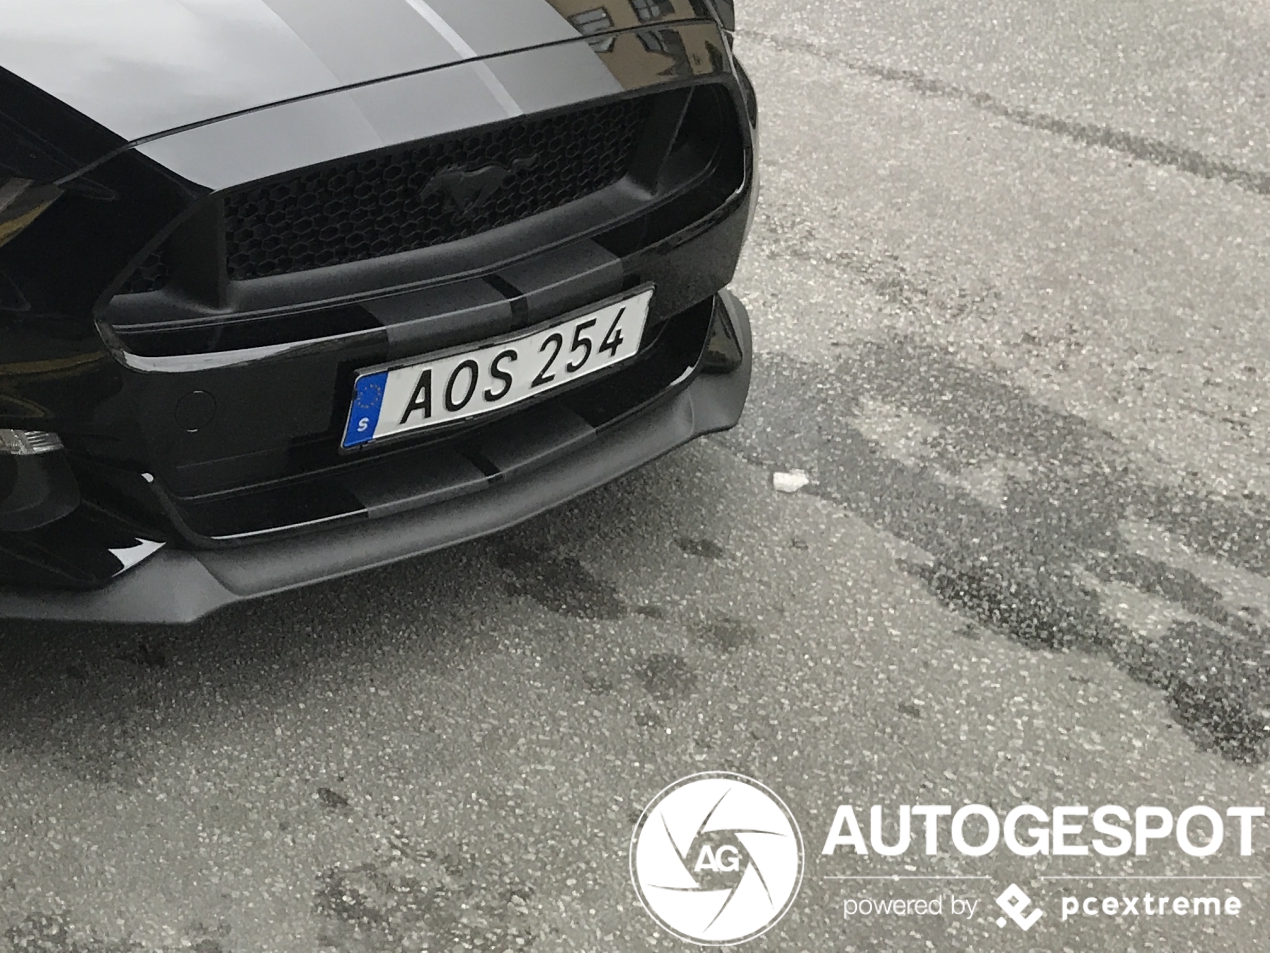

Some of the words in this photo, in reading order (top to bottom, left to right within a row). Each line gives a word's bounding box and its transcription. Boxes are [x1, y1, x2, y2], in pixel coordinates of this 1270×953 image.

[399, 350, 518, 425] AOS
[531, 306, 625, 389] 254
[357, 417, 368, 433] S
